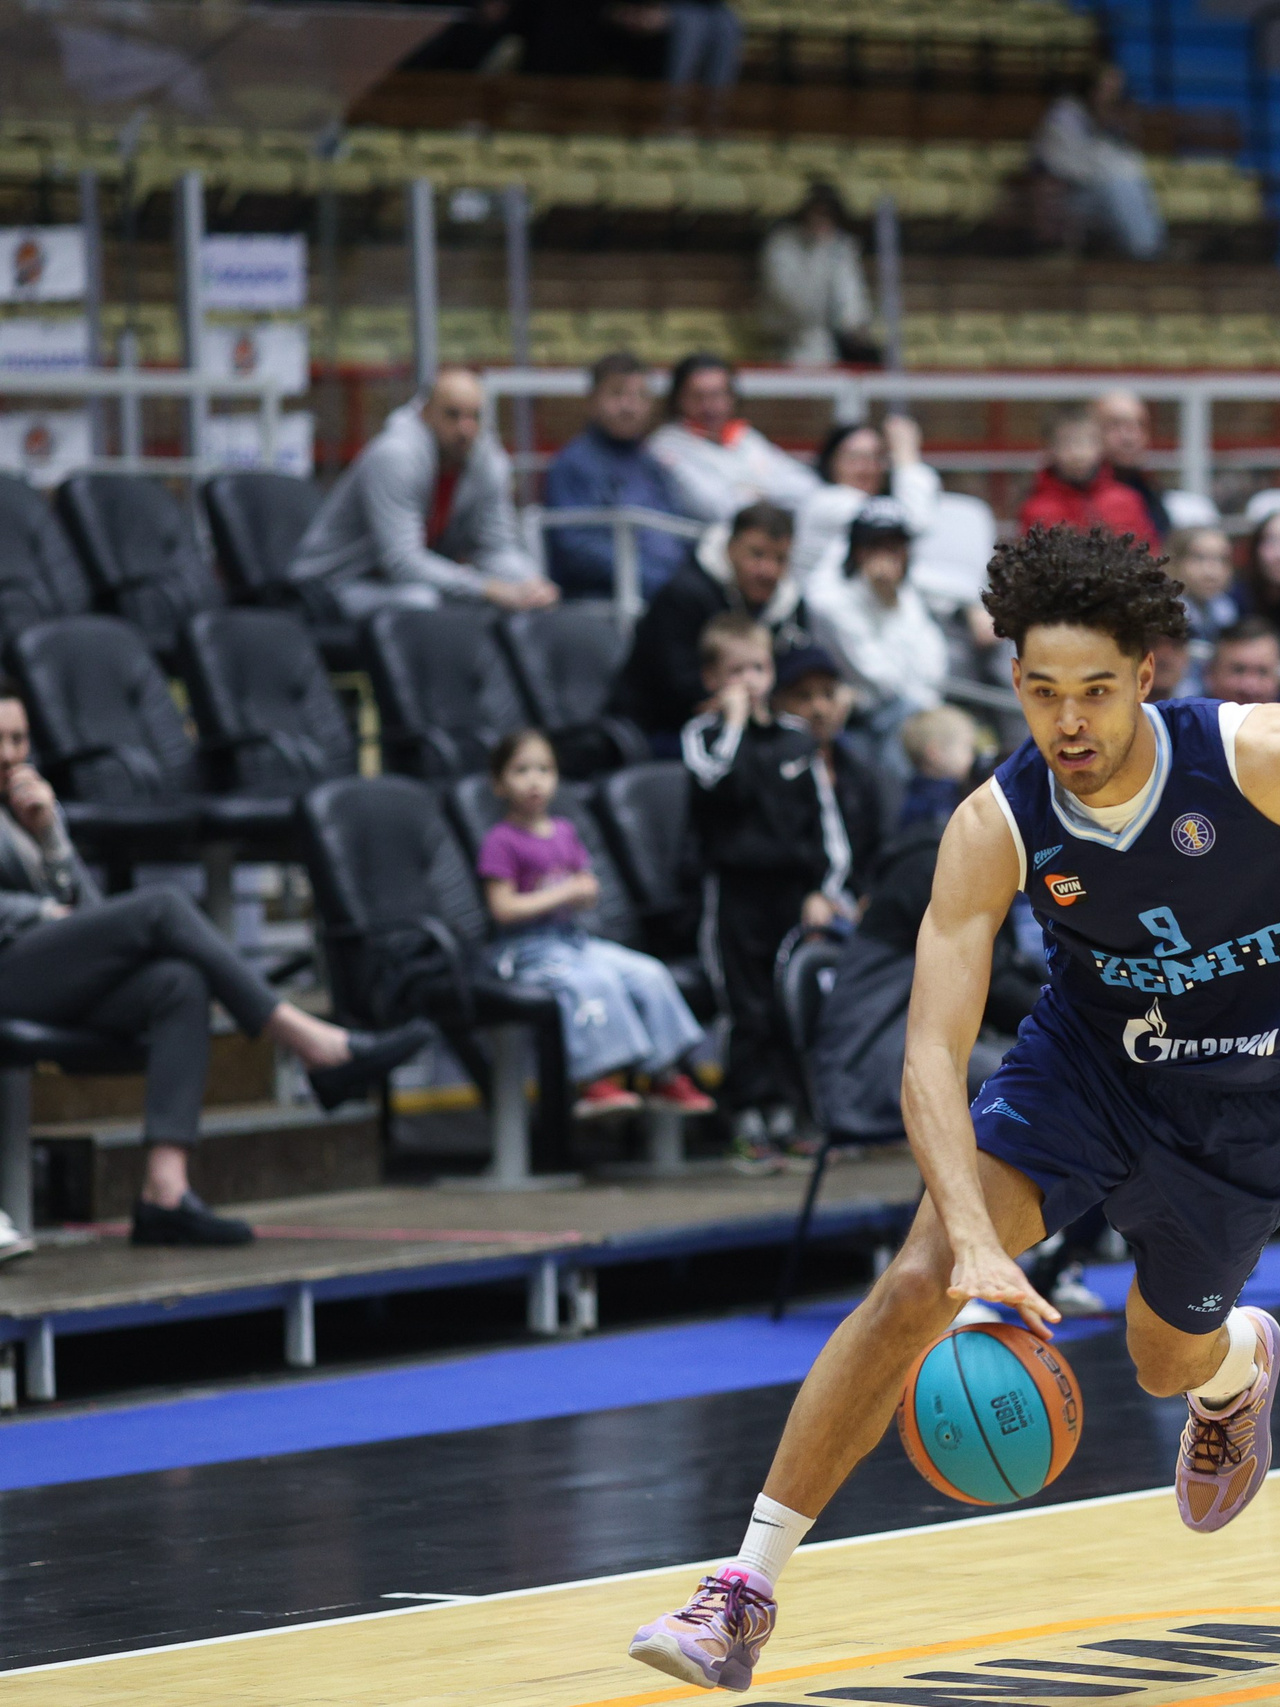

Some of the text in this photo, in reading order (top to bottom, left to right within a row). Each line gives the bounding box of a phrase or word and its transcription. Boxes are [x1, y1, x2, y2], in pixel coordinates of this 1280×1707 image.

[1056, 880, 1082, 895] WIN
[1138, 906, 1192, 958] 9
[1187, 1302, 1223, 1314] KELME
[990, 1393, 1020, 1437] FIBA
